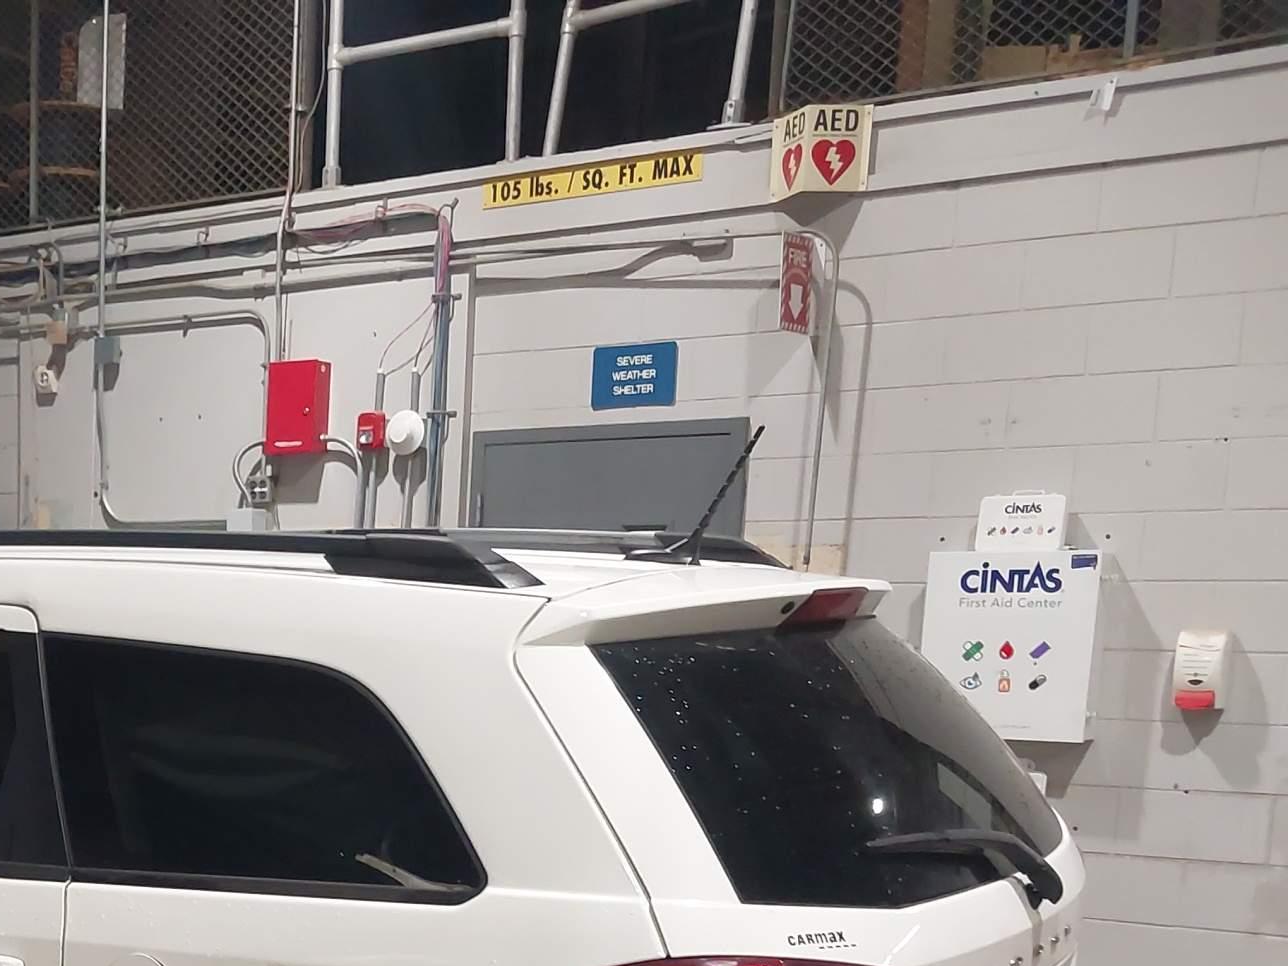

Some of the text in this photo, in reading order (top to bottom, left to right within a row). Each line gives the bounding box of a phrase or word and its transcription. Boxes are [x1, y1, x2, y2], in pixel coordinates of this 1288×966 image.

[783, 112, 806, 143] AED
[813, 109, 859, 132] AED
[492, 154, 694, 203] 105 lbs. / SQ. FT. MAX
[788, 247, 808, 268] FIRE
[616, 354, 653, 367] SEVERE
[612, 369, 656, 382] WEATHER
[613, 383, 654, 396] SHELTER
[959, 597, 1063, 608] First Aid Center
